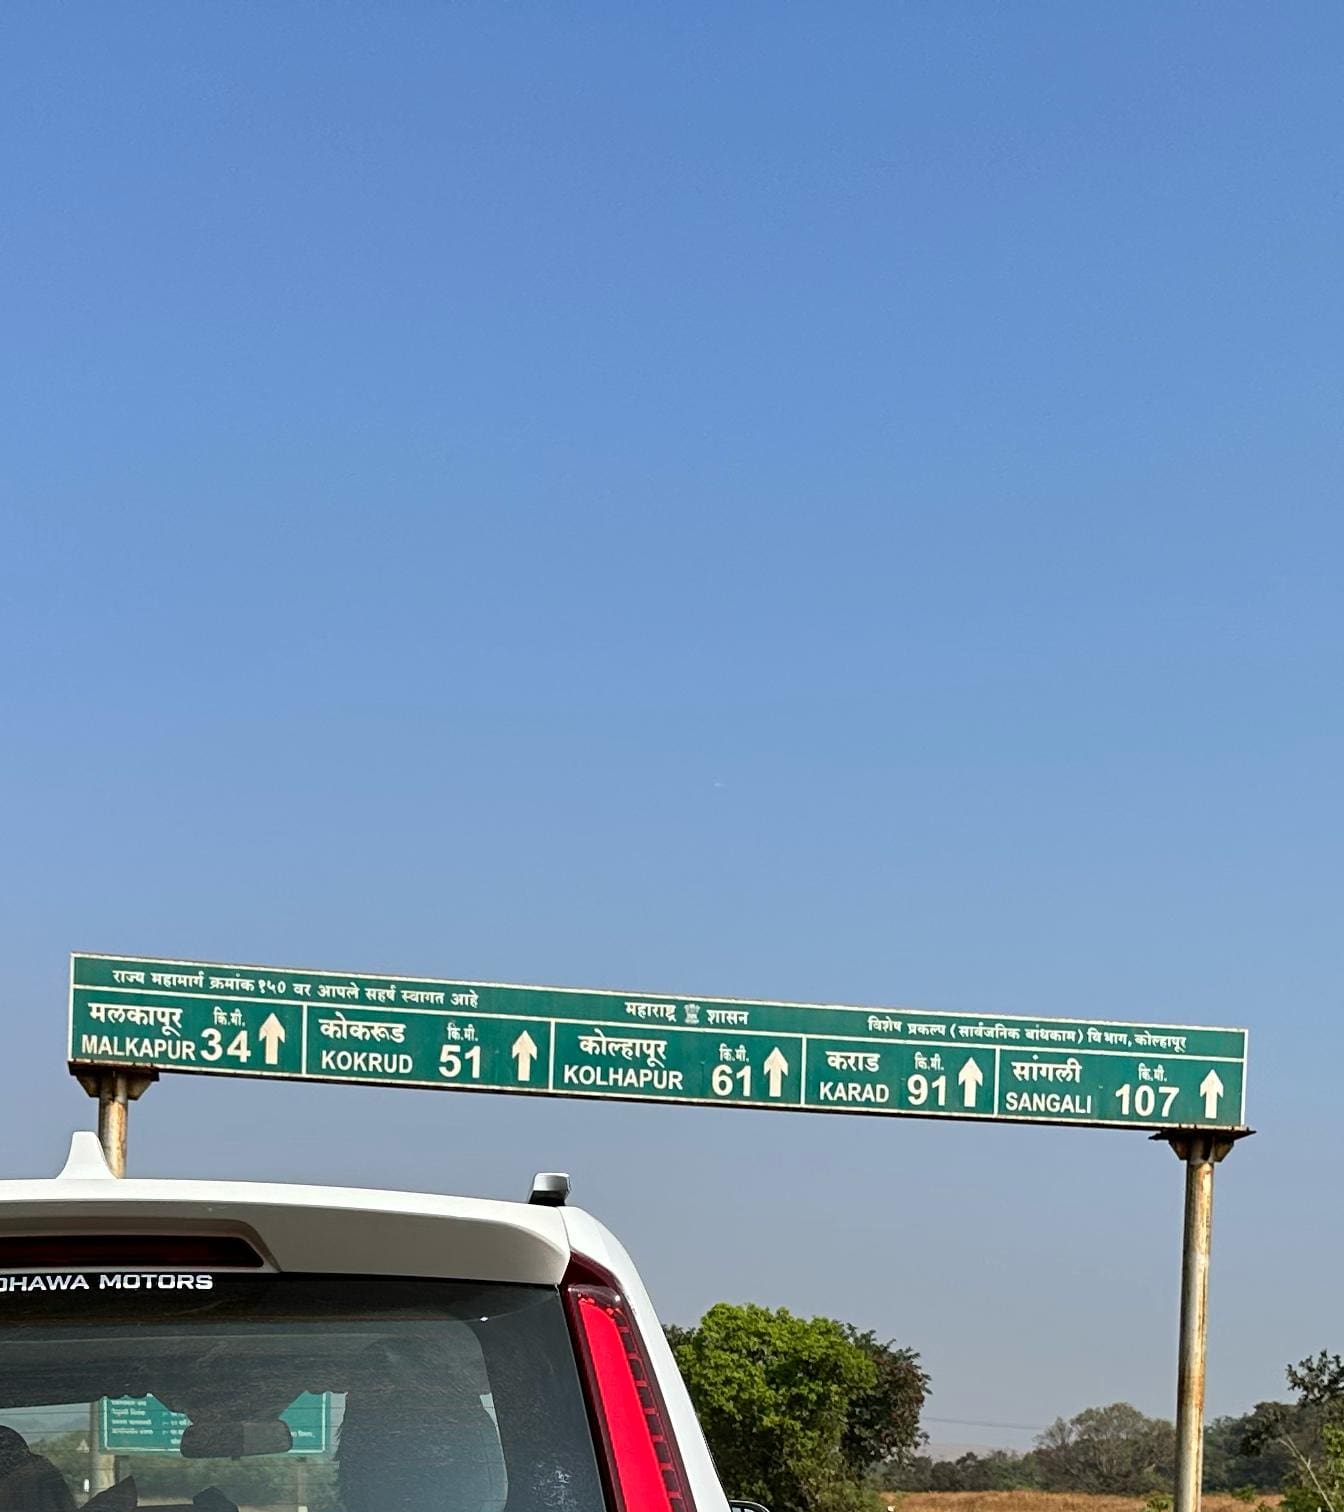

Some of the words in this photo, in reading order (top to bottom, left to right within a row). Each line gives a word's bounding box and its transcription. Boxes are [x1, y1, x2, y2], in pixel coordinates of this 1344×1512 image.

[112, 970, 145, 985] राज्य
[151, 970, 205, 989] महामार्ग
[209, 973, 255, 992] क्रमांक
[292, 983, 312, 997] वर
[317, 982, 360, 999] आपले
[365, 984, 396, 1002] सहर्ष
[401, 989, 445, 1006] स्वागत
[450, 989, 479, 1009] आहे
[88, 1003, 183, 1037] मलकापूर
[318, 1011, 406, 1043] कोकरूड
[624, 1001, 677, 1022] महाराष्ट्र
[706, 1009, 749, 1025] शासन
[81, 1034, 196, 1061] MALKAPUR
[200, 1028, 252, 1063] 34
[578, 1028, 668, 1069] कोल्हापूर
[867, 1015, 902, 1033] विशेष
[906, 1023, 946, 1036] प्रकल्प
[1134, 1030, 1186, 1053] कोल्हापूर
[321, 1050, 413, 1074] KOKRUD
[438, 1044, 481, 1079] 51
[825, 1051, 881, 1072] कराड
[1011, 1054, 1082, 1083] सांगली
[563, 1064, 683, 1090] KOLHAPUR
[711, 1064, 752, 1097] 61
[819, 1081, 890, 1103] KARAD
[907, 1073, 947, 1106] 91
[1005, 1091, 1092, 1114] SANGALI
[1115, 1083, 1180, 1118] 107
[99, 1274, 214, 1290] MOTORS
